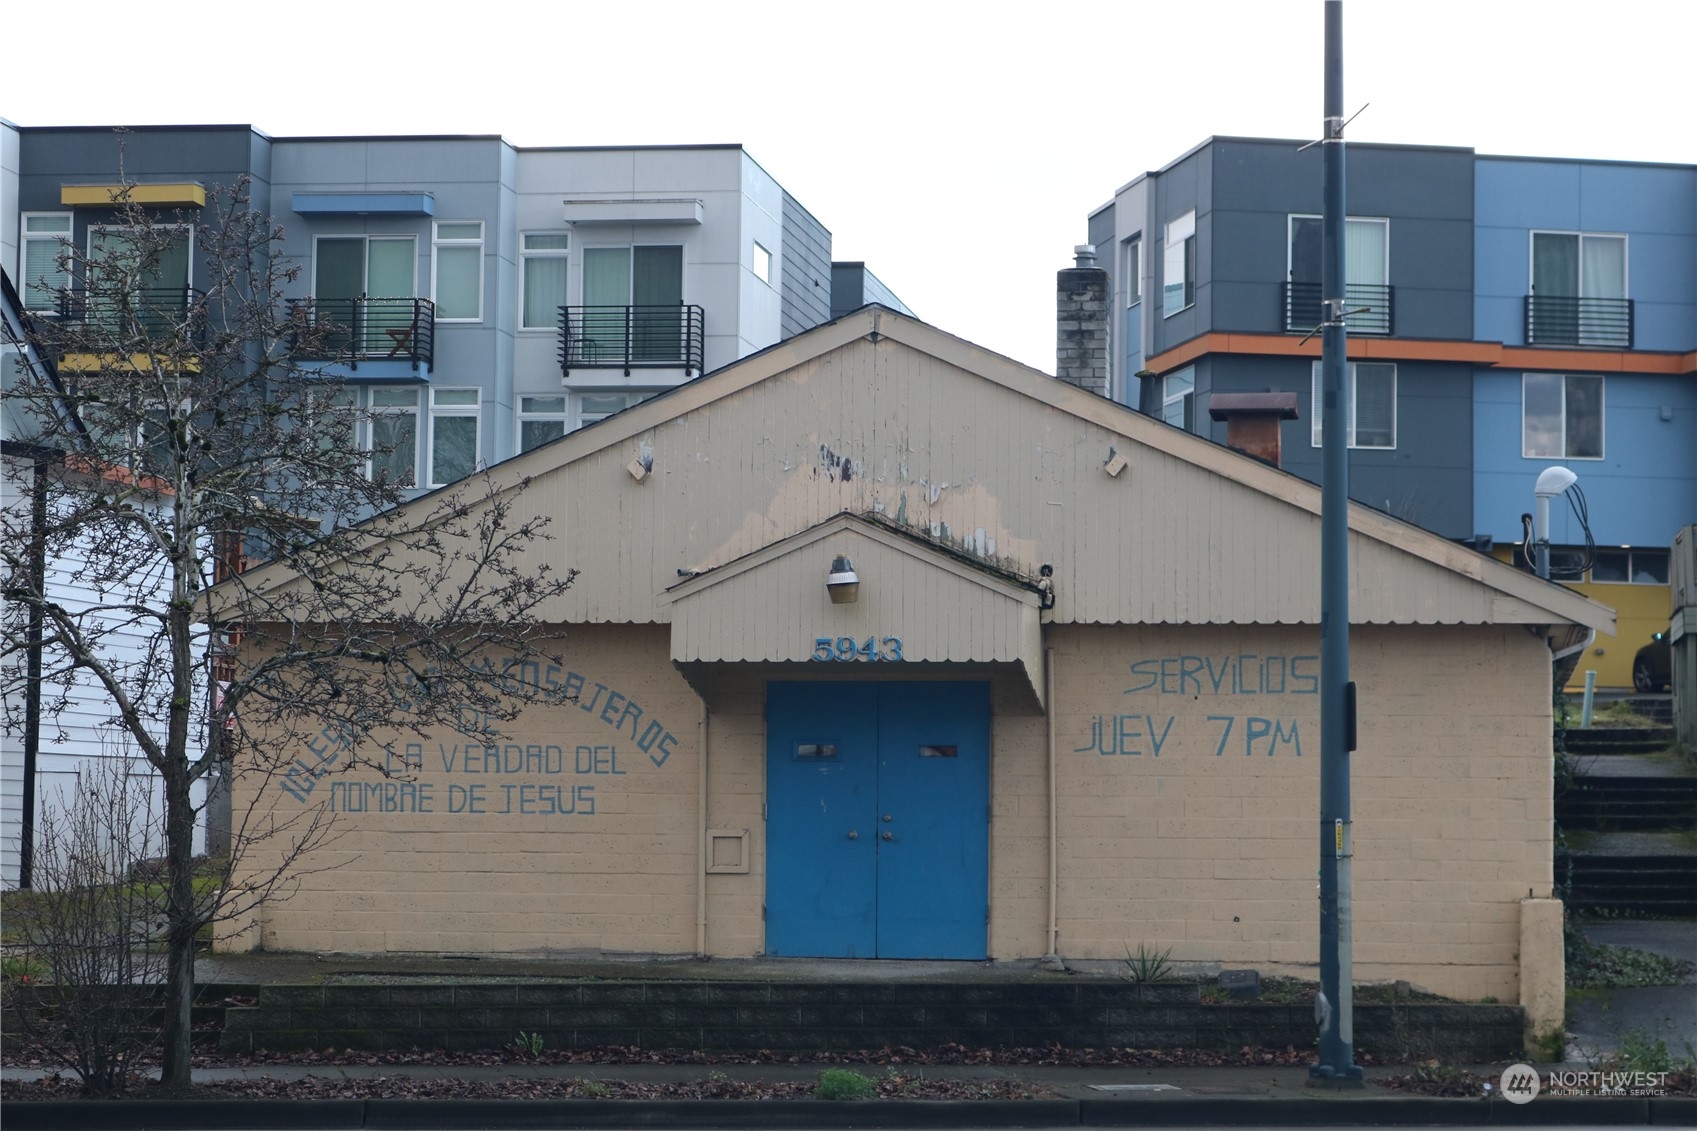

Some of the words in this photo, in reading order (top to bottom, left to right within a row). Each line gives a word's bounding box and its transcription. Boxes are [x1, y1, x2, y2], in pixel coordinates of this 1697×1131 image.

[811, 636, 904, 662] 5943
[385, 743, 422, 773] LA
[575, 745, 627, 775] DEL
[330, 781, 434, 814] NOMBRE
[447, 783, 487, 815] DE
[496, 785, 596, 816] JESUS
